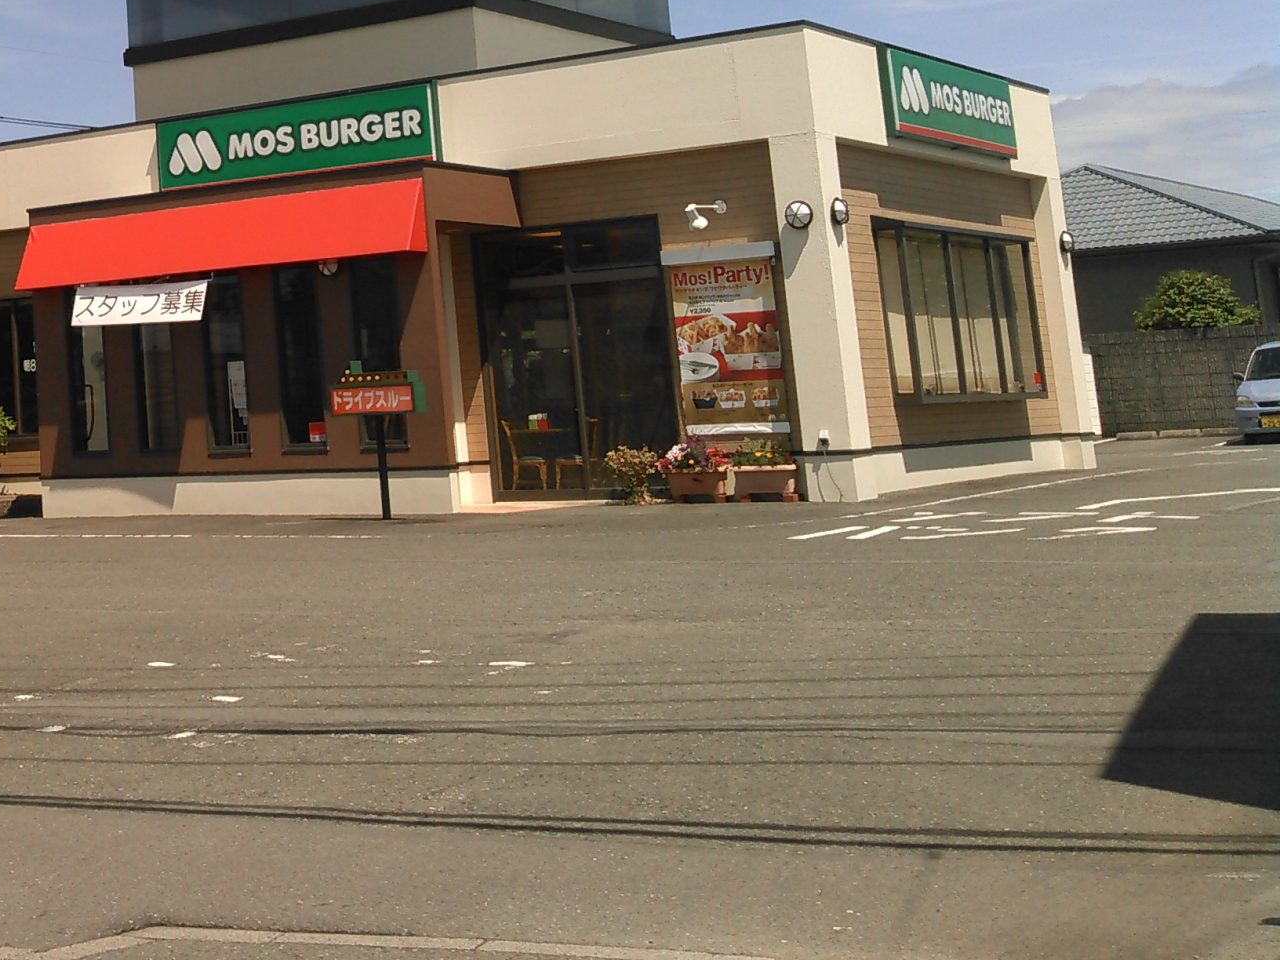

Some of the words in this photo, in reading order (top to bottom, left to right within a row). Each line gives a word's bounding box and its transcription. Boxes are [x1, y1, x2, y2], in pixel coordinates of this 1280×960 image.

[930, 81, 962, 115] MOS
[962, 89, 1012, 127] BURGER
[228, 125, 295, 160] MOS
[300, 109, 422, 150] BURGER
[75, 289, 204, 318] スタッフ募集
[333, 390, 411, 411] ドライブスルー
